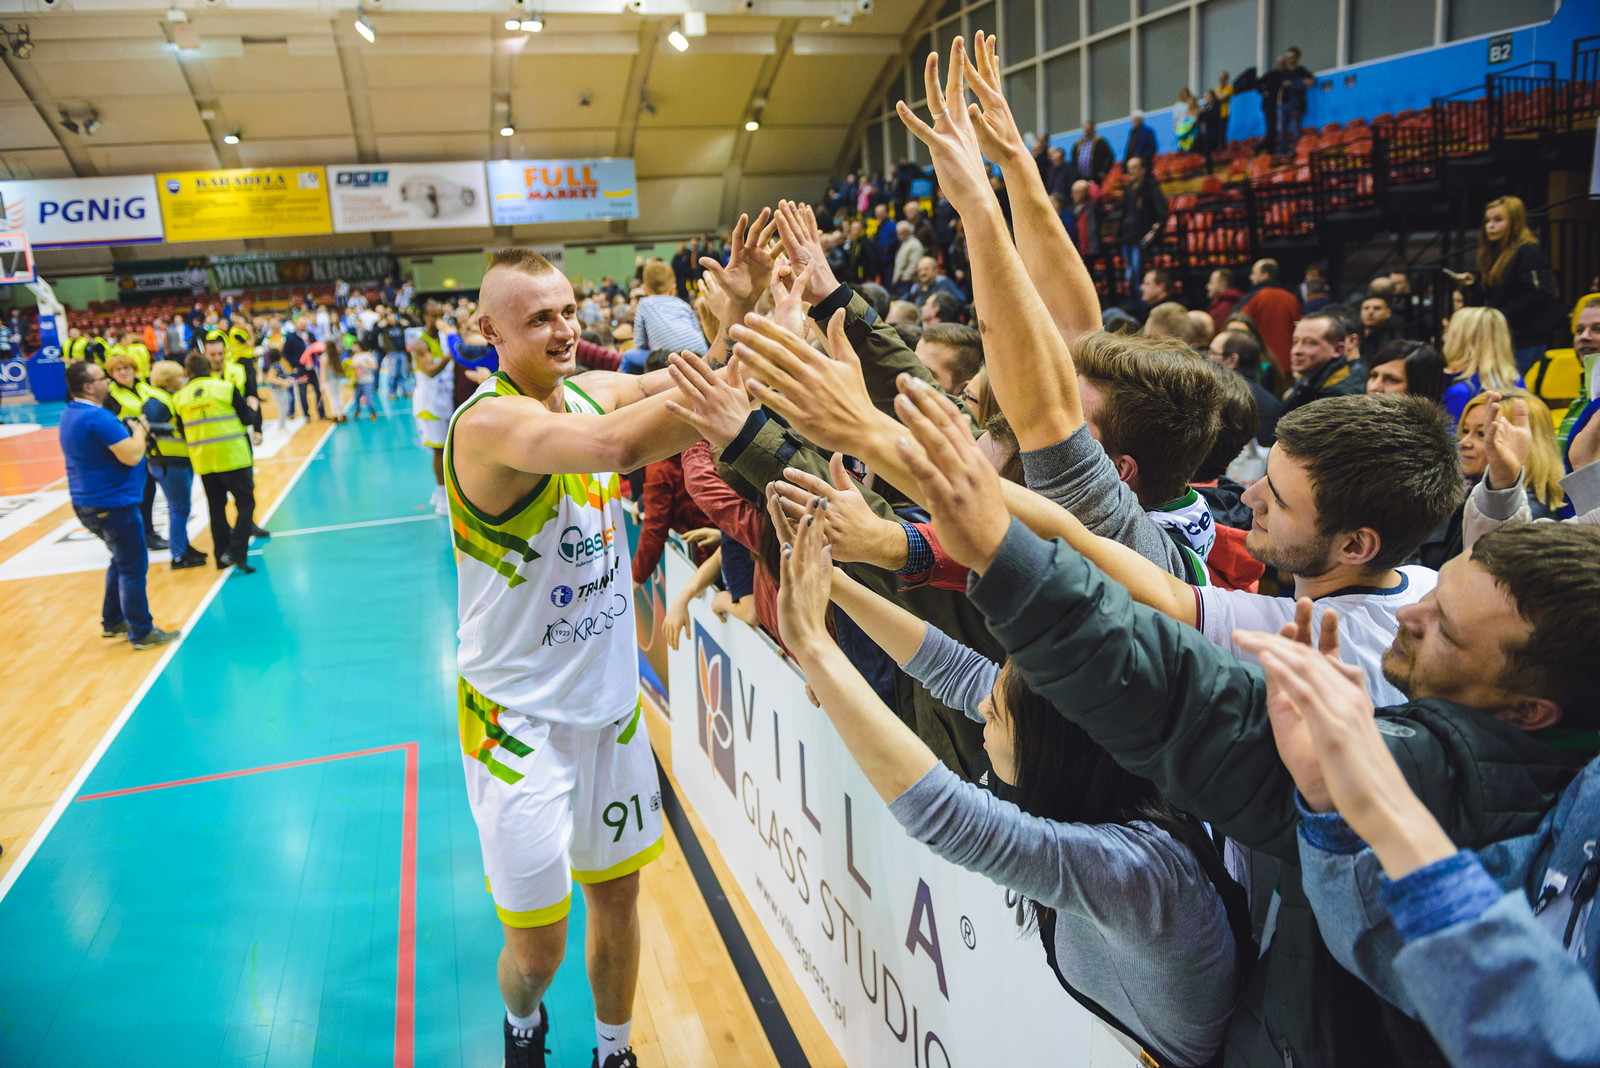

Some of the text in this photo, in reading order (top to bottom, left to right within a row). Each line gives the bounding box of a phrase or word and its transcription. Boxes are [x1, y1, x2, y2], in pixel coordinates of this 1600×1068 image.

[1490, 44, 1511, 62] B2
[524, 165, 598, 187] FULL
[528, 188, 598, 200] MARKET
[39, 196, 146, 224] PGNiG
[214, 262, 279, 287] MOSIR
[311, 255, 391, 281] KROSNO
[555, 629, 571, 637] 1923
[602, 793, 643, 843] 91
[737, 667, 950, 1002] VILLA
[742, 771, 810, 905] GLASS
[755, 871, 847, 1029] www.villaglass.pl
